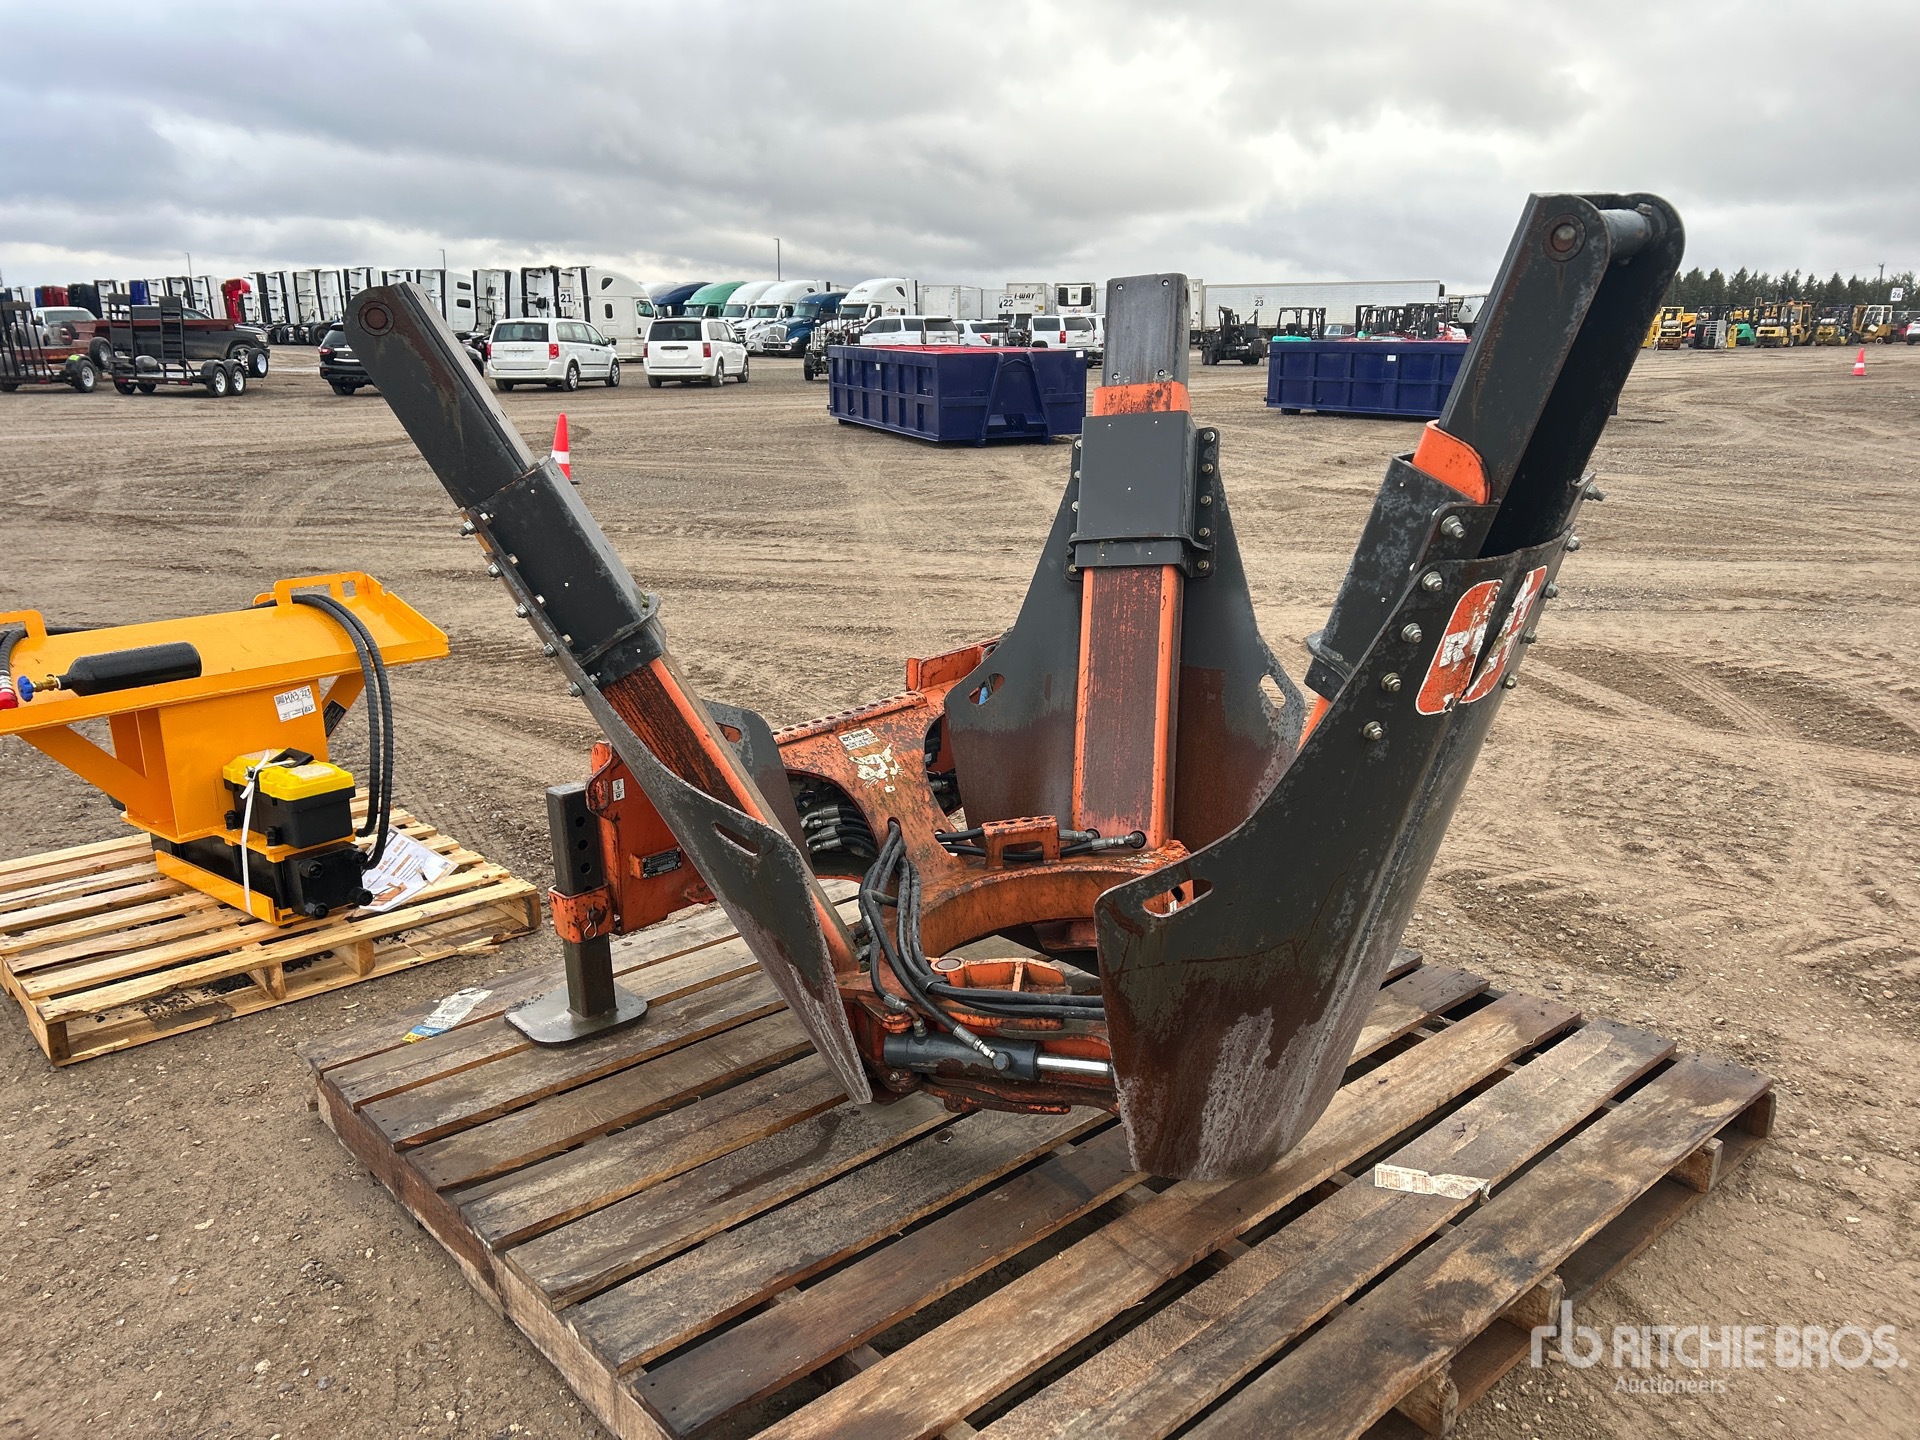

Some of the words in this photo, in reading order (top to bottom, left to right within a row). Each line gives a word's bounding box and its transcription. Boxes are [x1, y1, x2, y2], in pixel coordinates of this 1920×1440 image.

[560, 293, 572, 303] 21
[1892, 291, 1901, 299] 26
[1003, 299, 1014, 307] 22
